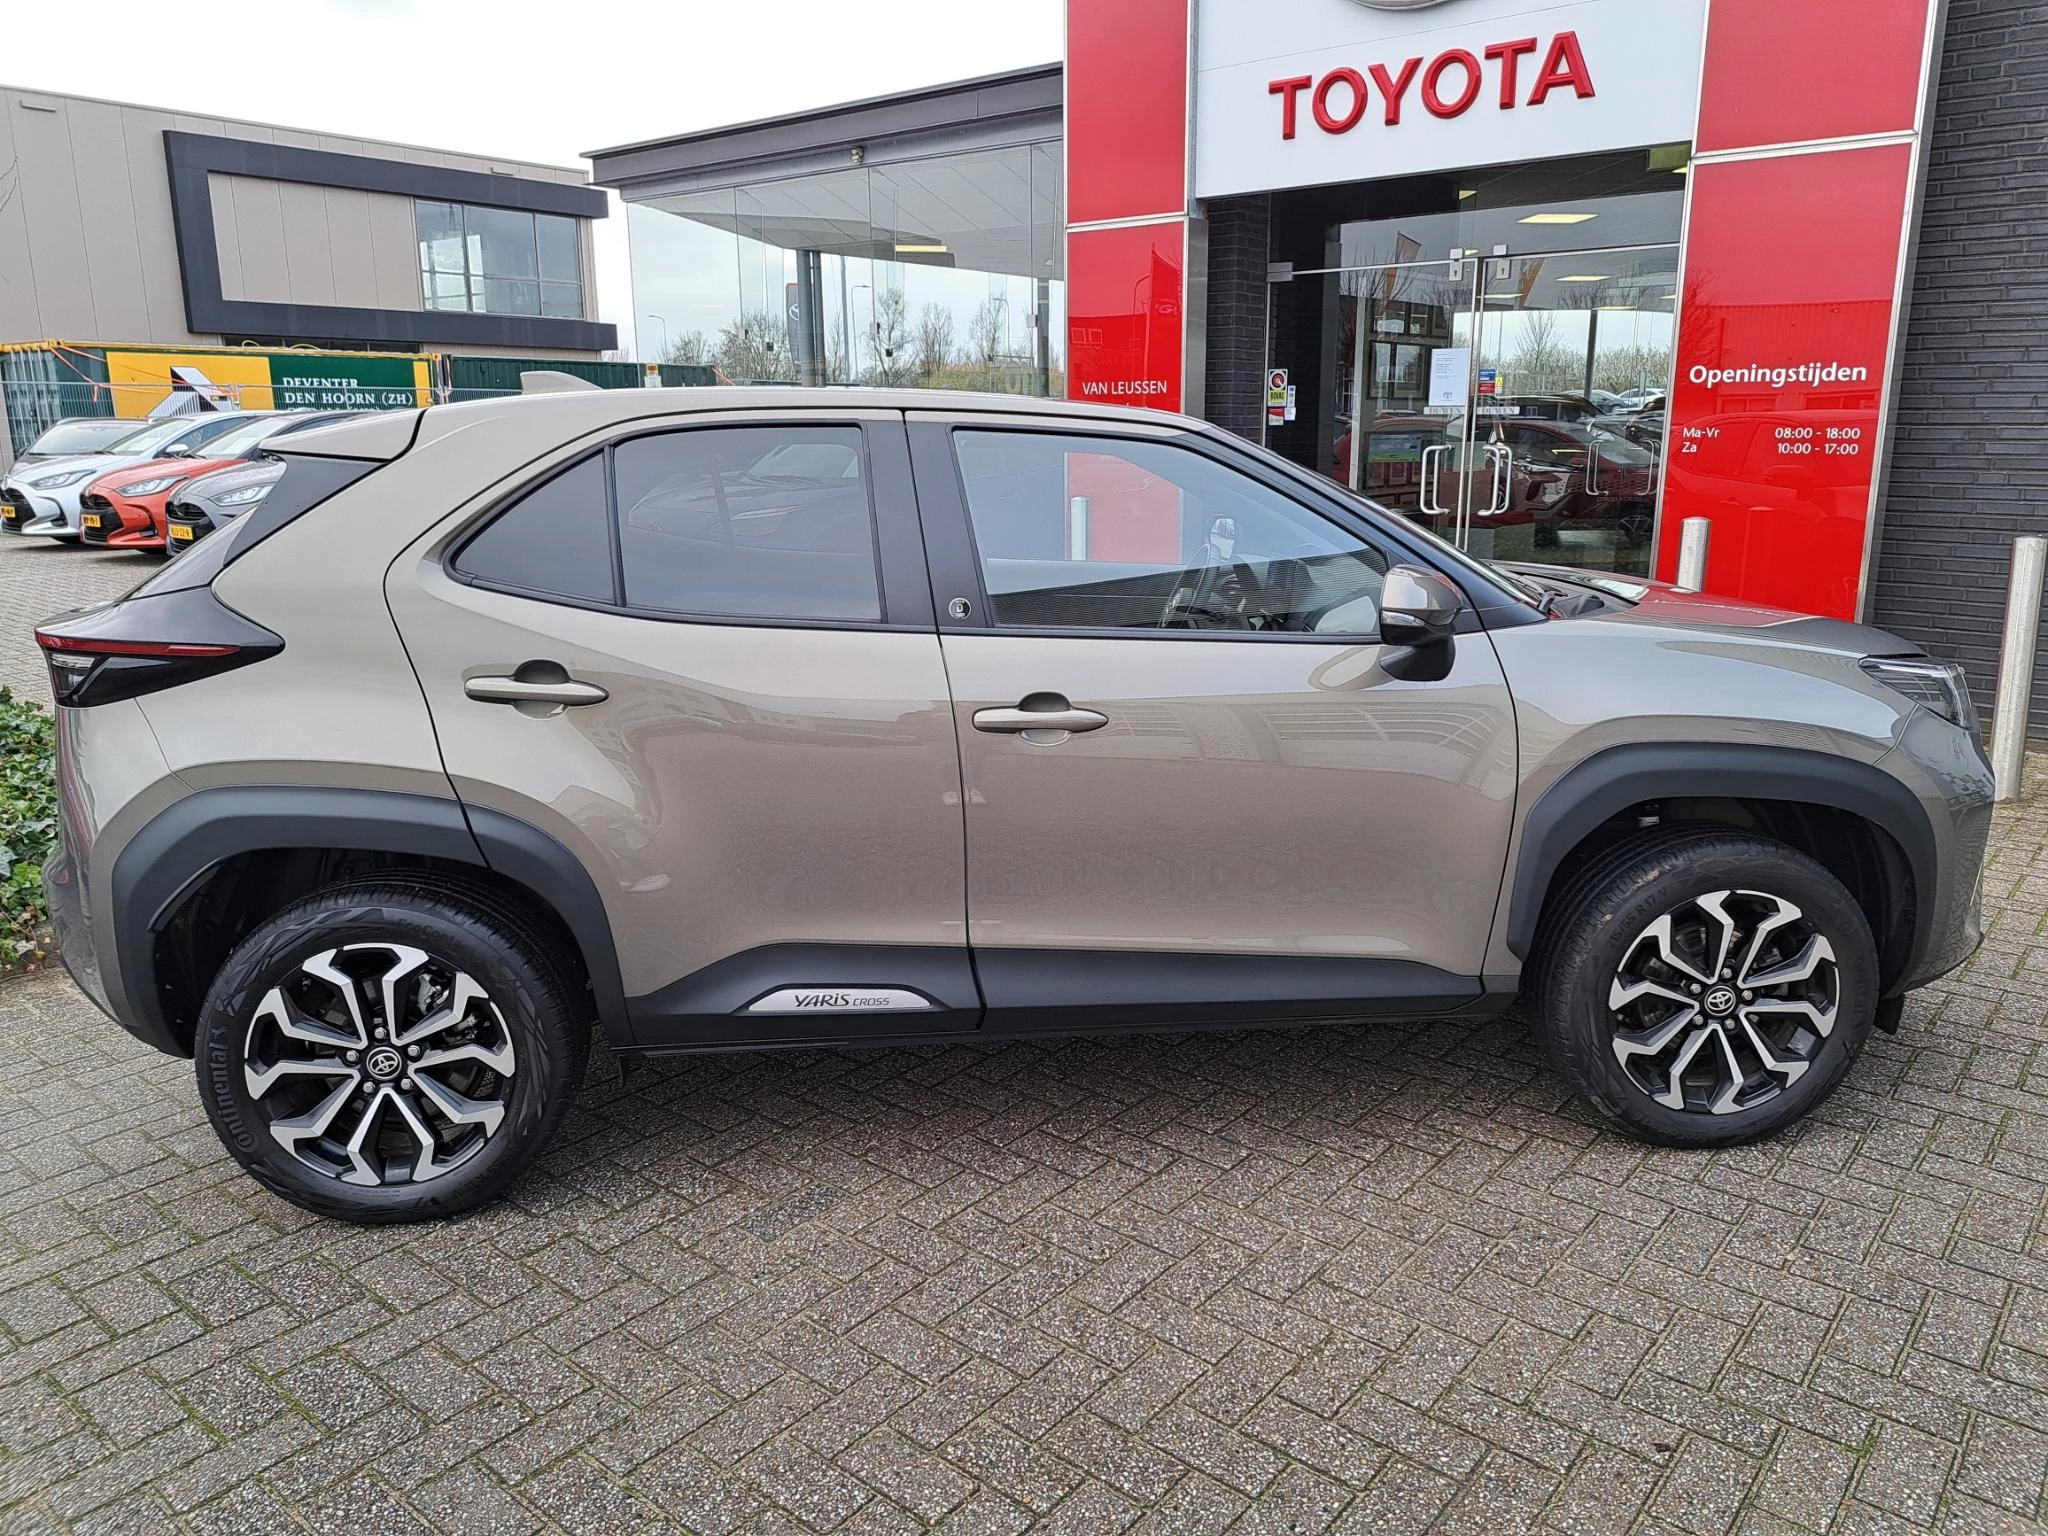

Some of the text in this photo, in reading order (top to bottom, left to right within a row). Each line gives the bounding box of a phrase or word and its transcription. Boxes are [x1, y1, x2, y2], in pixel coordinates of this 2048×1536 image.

[1268, 31, 1596, 140] TOYOTA
[1689, 362, 1867, 388] Openingstijden
[282, 377, 359, 388] DEVENTER
[1082, 380, 1168, 395] VAN LEUSSEN
[284, 392, 413, 406] DEN HOORN (ZH)
[1683, 427, 1720, 438] Ma-Vr
[1775, 427, 1813, 439] 08:00
[1826, 427, 1861, 439] 18:00
[1682, 442, 1697, 453] Za
[1777, 443, 1811, 455] 10:00
[1824, 443, 1859, 455] 17:00
[852, 997, 890, 1007] CROSS
[208, 1040, 257, 1152] Continental
